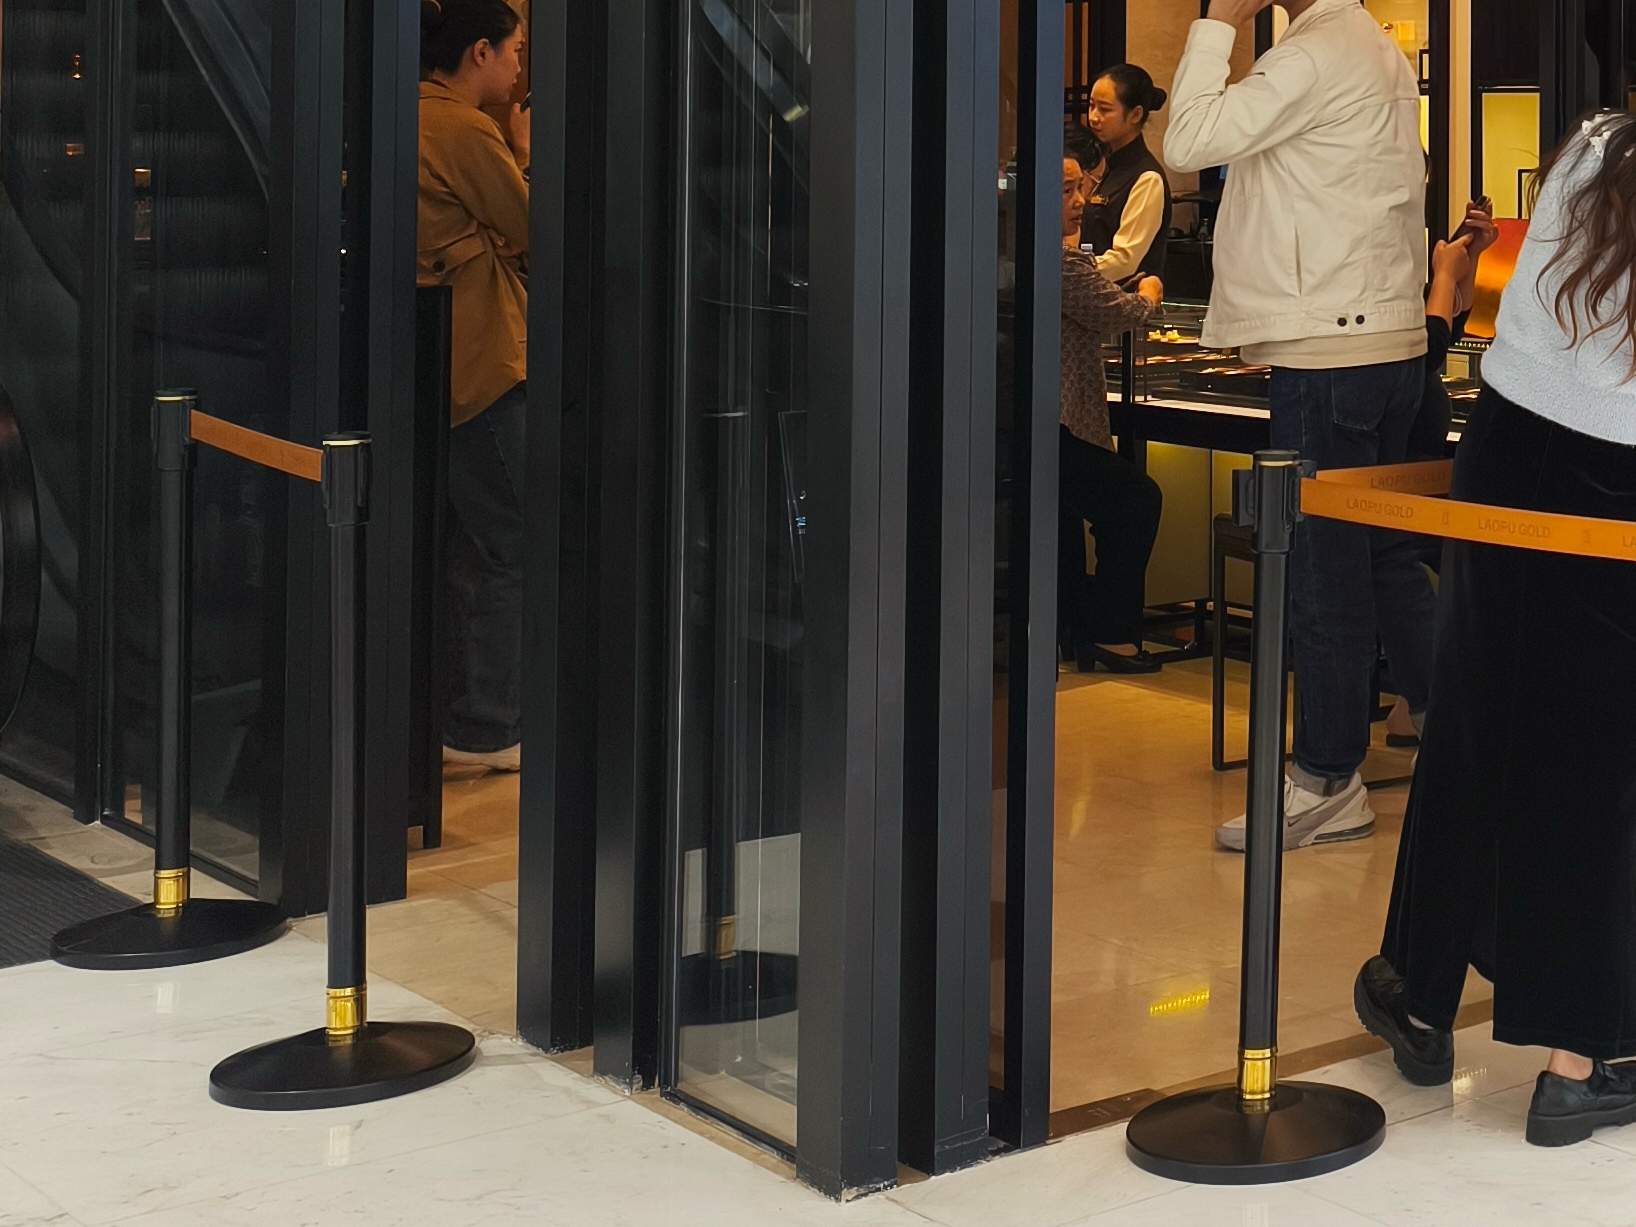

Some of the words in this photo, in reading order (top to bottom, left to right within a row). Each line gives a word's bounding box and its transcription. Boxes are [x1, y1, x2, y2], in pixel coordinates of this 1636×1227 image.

[1347, 497, 1382, 514] LAOPU
[1384, 503, 1414, 519] GOLD
[1478, 517, 1516, 535] LAOPU
[1519, 523, 1551, 540] GOLD
